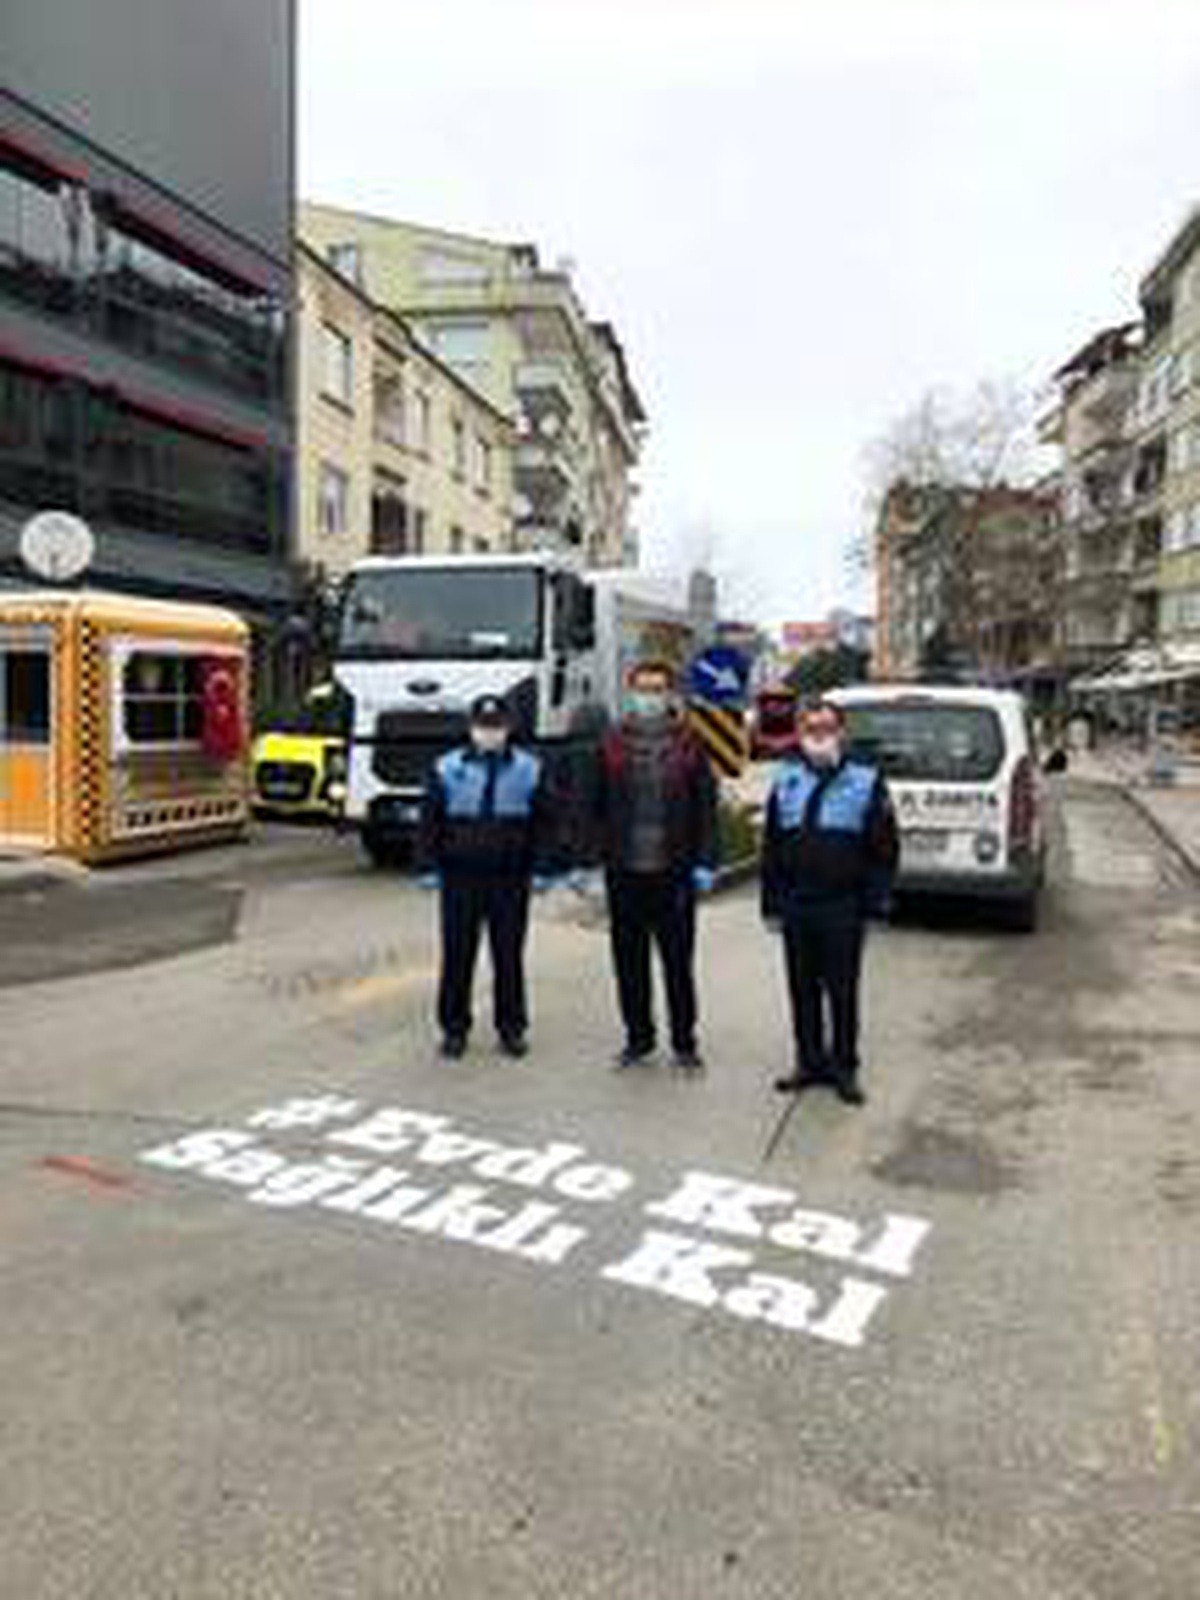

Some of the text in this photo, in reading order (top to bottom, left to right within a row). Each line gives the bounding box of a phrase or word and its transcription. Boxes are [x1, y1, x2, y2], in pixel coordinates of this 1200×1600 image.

[138, 1130, 888, 1347] Sağlıklı Kal
[643, 1170, 932, 1277] Kal
